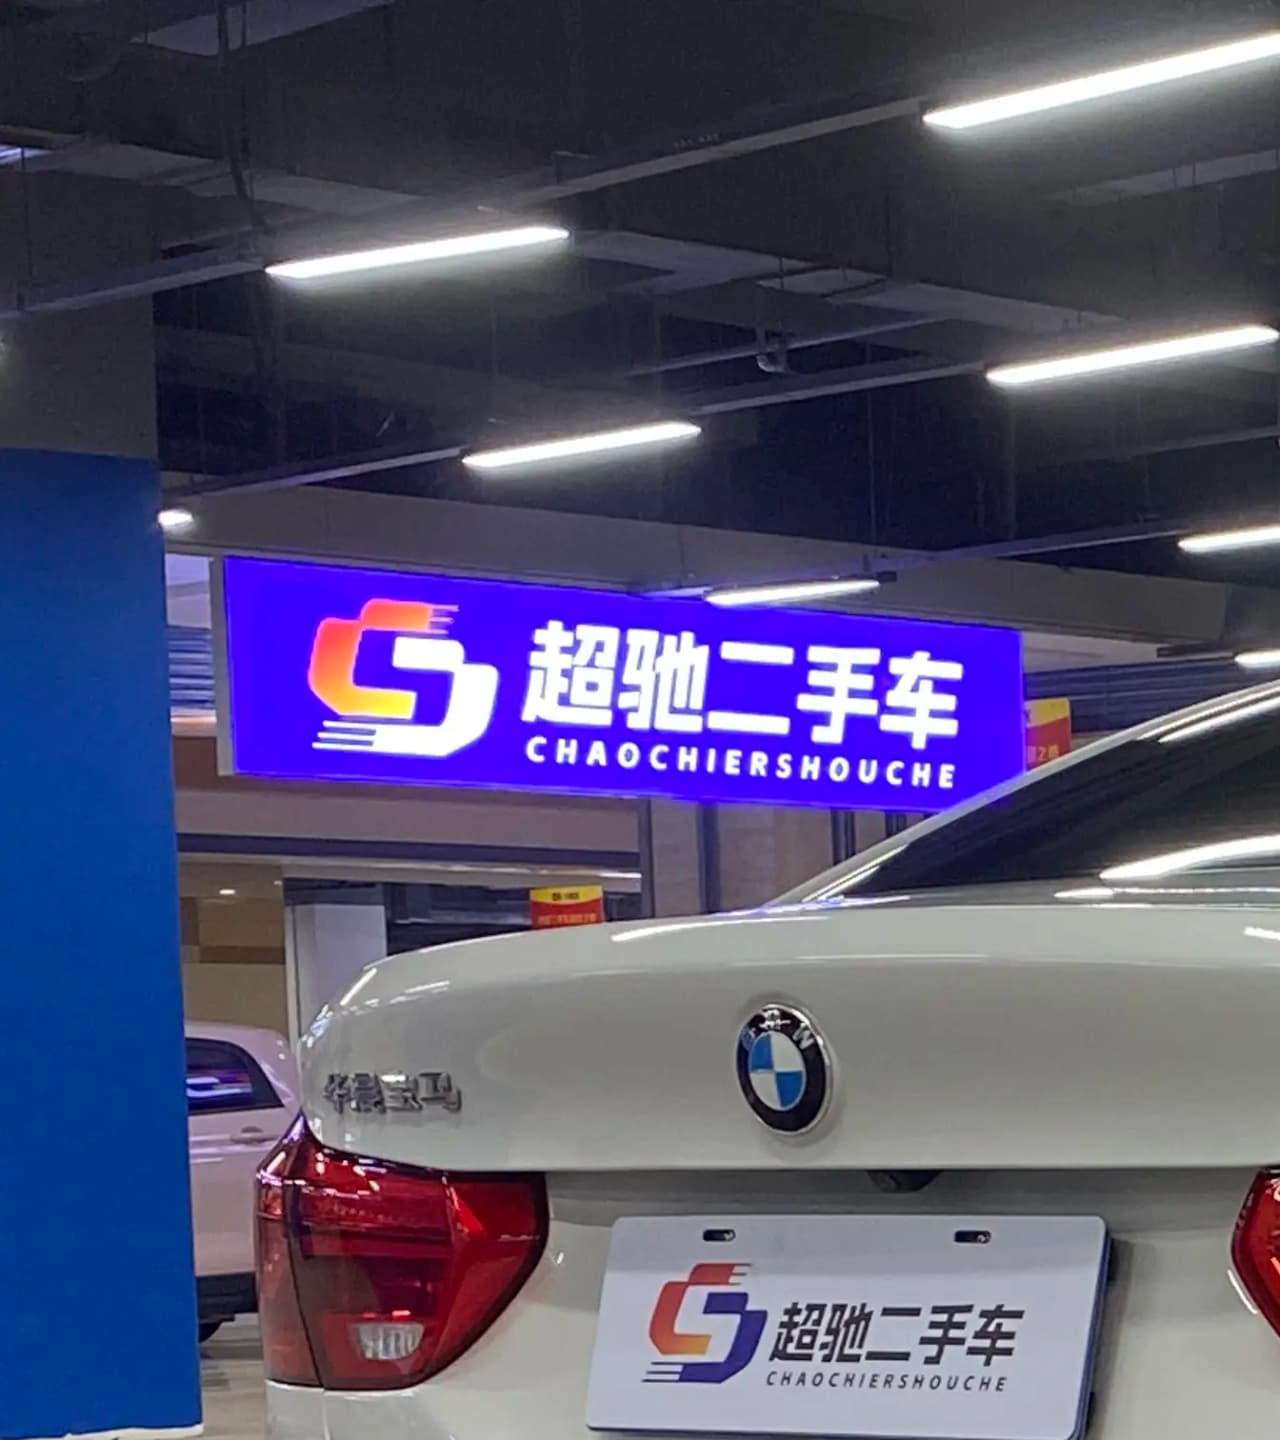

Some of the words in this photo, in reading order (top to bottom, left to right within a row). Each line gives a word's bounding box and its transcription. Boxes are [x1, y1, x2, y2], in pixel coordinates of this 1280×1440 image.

[520, 619, 964, 750] 超驰二手车
[525, 735, 956, 789] CHAOCHIERSHOUCHE
[768, 1302, 1025, 1367] 超驰二手车
[766, 1370, 1008, 1392] CHAOCHIERSHOUCHE
